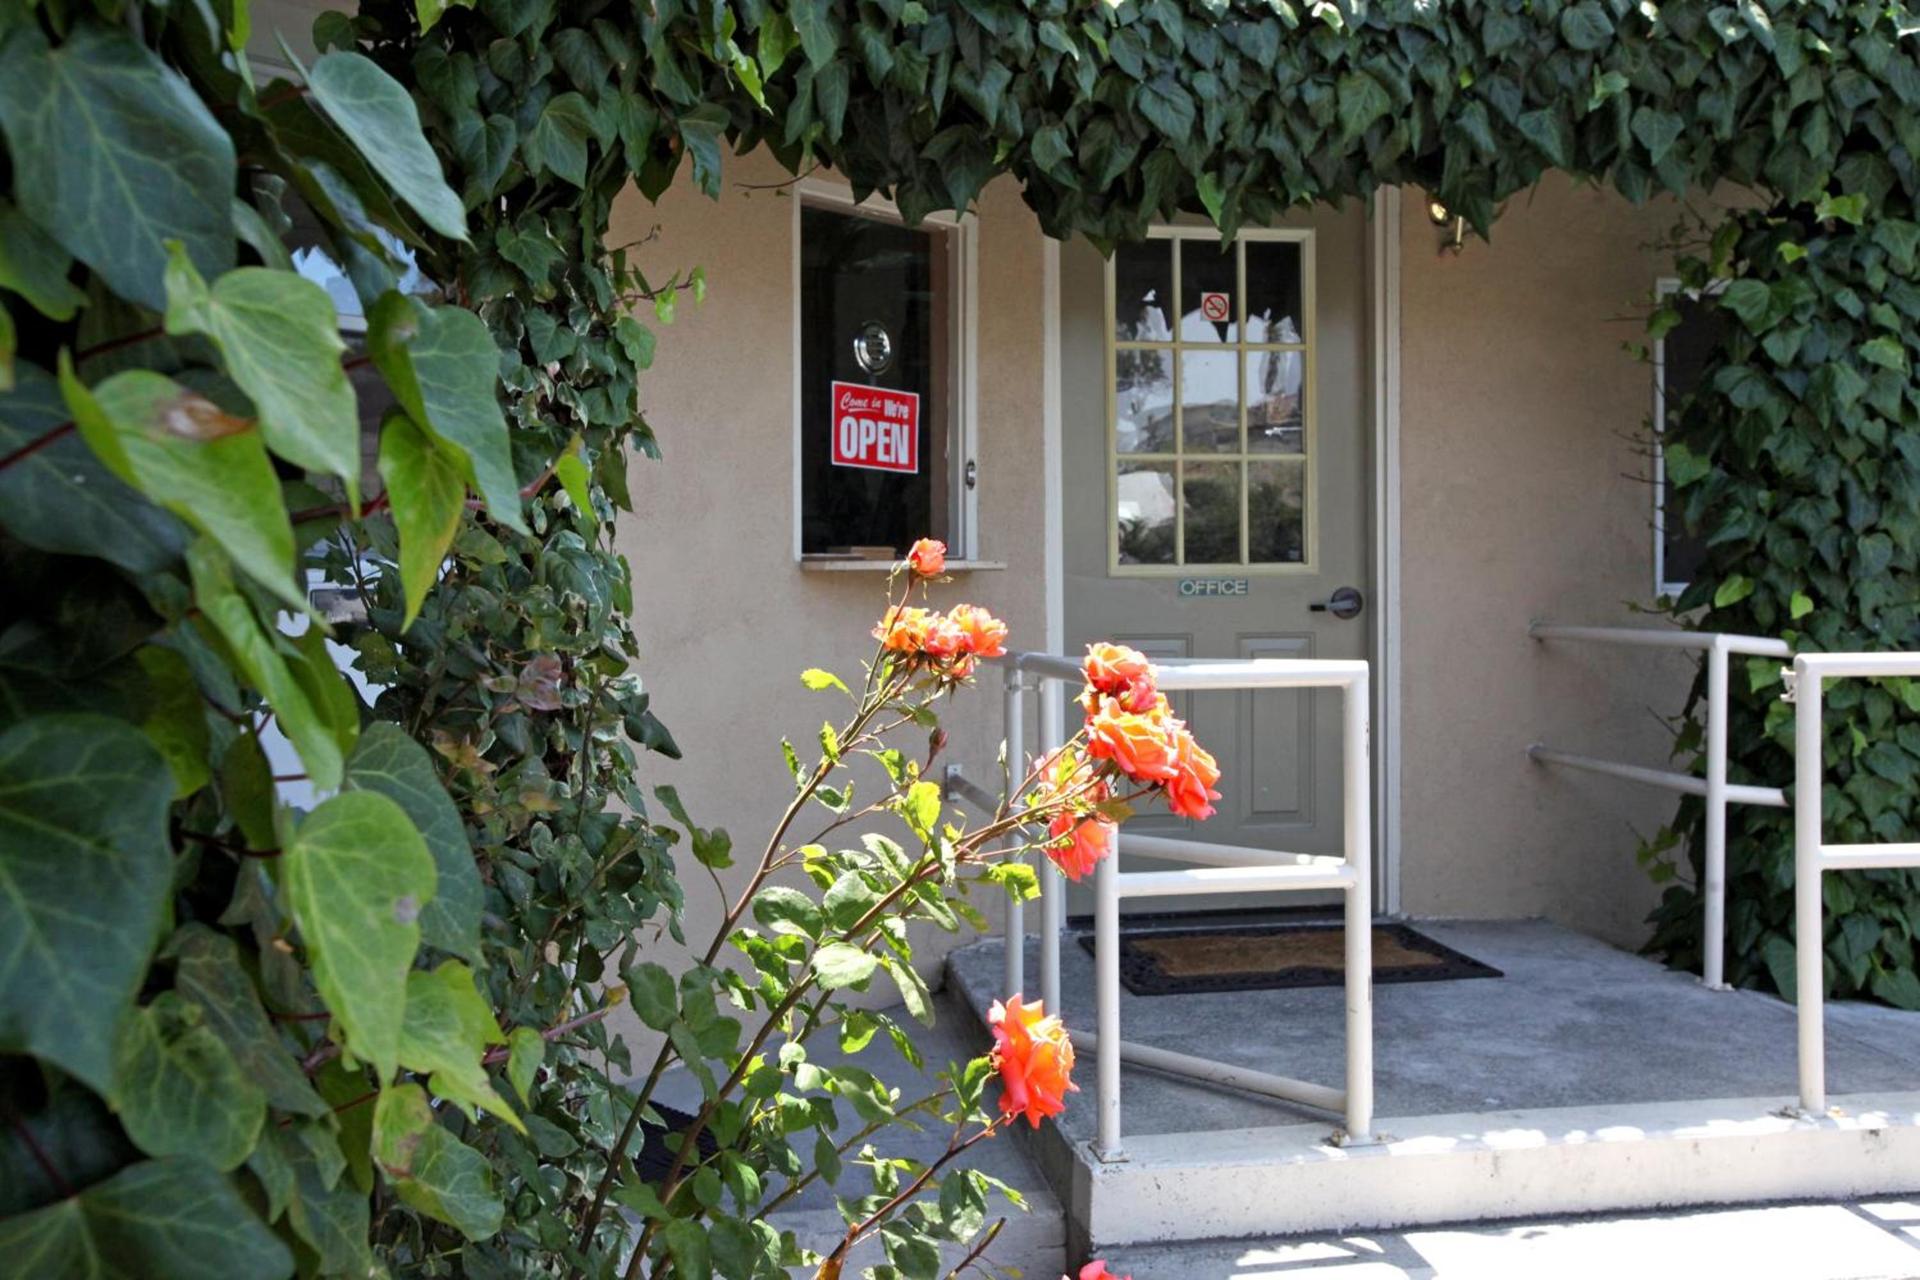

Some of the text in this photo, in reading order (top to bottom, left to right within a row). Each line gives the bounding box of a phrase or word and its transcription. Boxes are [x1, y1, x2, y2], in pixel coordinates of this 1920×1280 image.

[840, 391, 909, 419] Come in We're
[840, 415, 909, 465] OPEN
[1180, 580, 1247, 595] OFFICE
